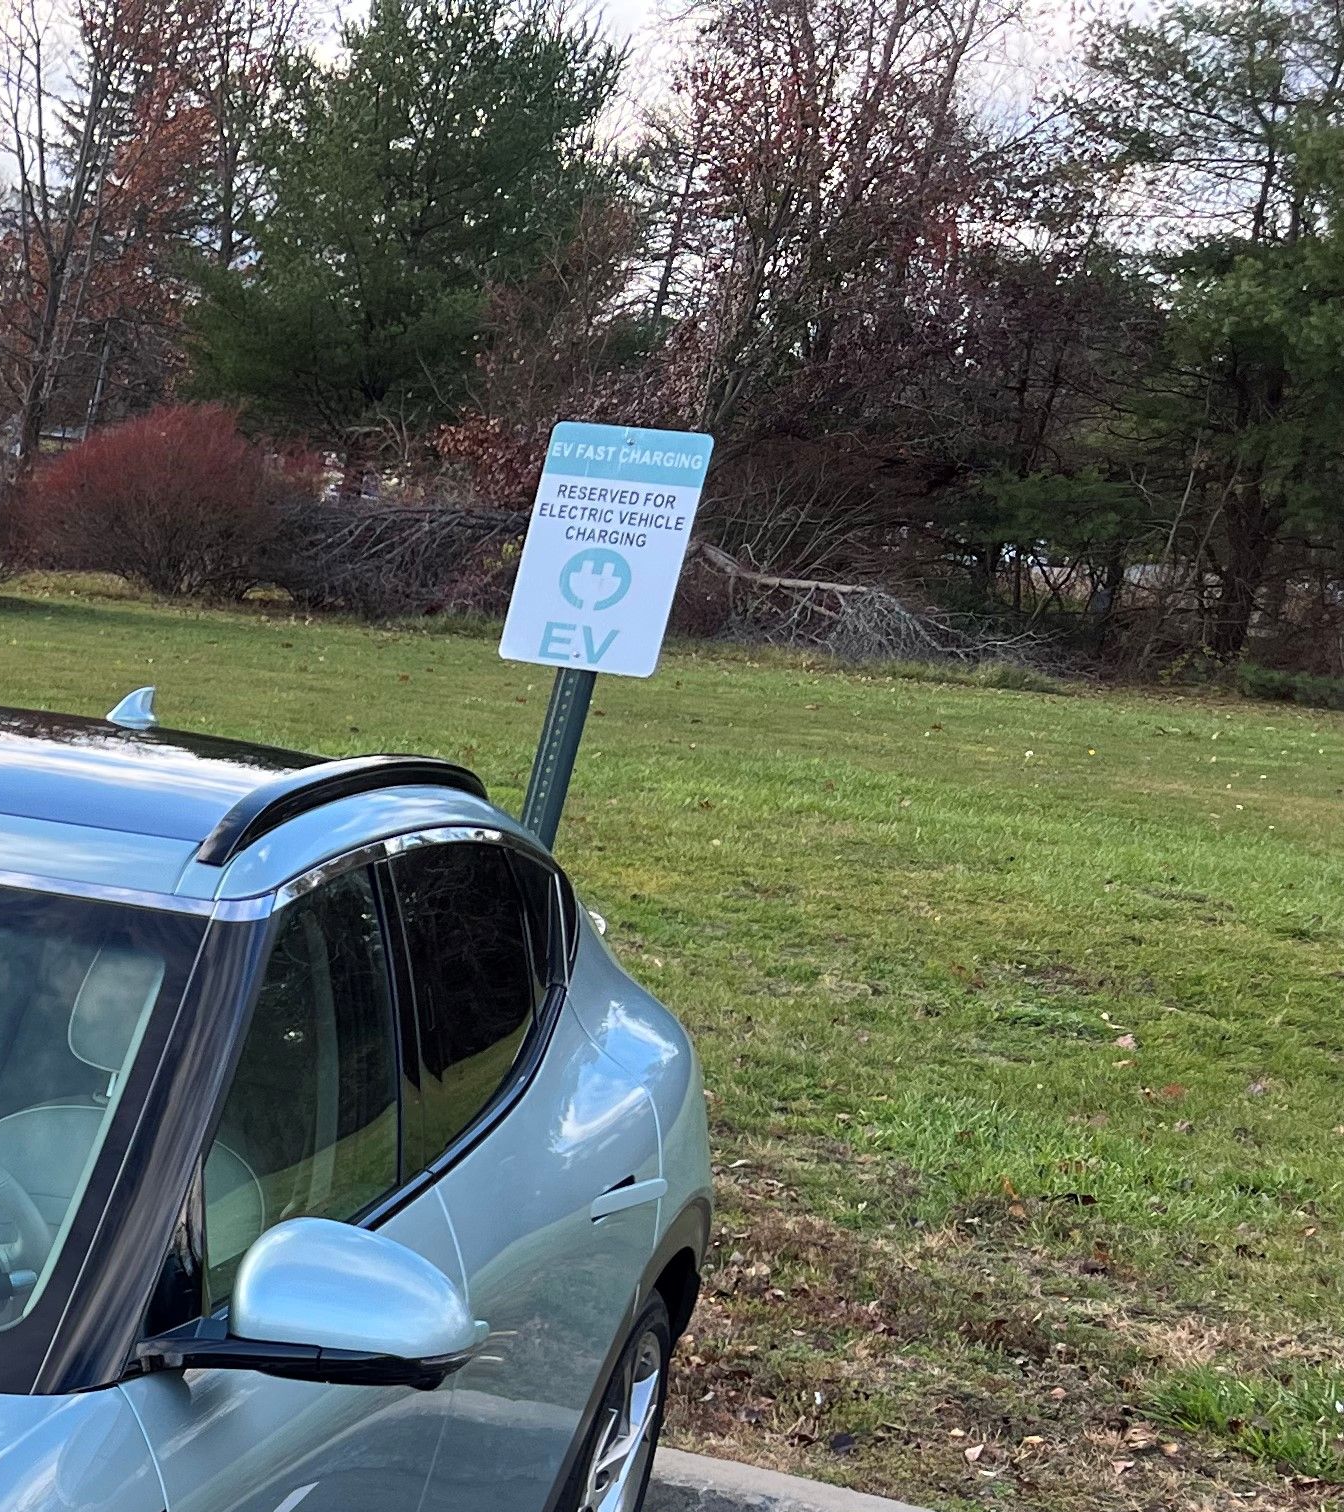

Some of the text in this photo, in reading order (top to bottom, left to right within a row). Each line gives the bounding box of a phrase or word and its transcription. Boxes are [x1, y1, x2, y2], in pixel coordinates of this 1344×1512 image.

[551, 441, 703, 470] EV FAST CHARGING
[557, 484, 677, 510] RESERVED FOR
[538, 502, 686, 531] ELECTRIC VEHICLE
[565, 525, 648, 547] CHARGING
[538, 621, 620, 665] EV
